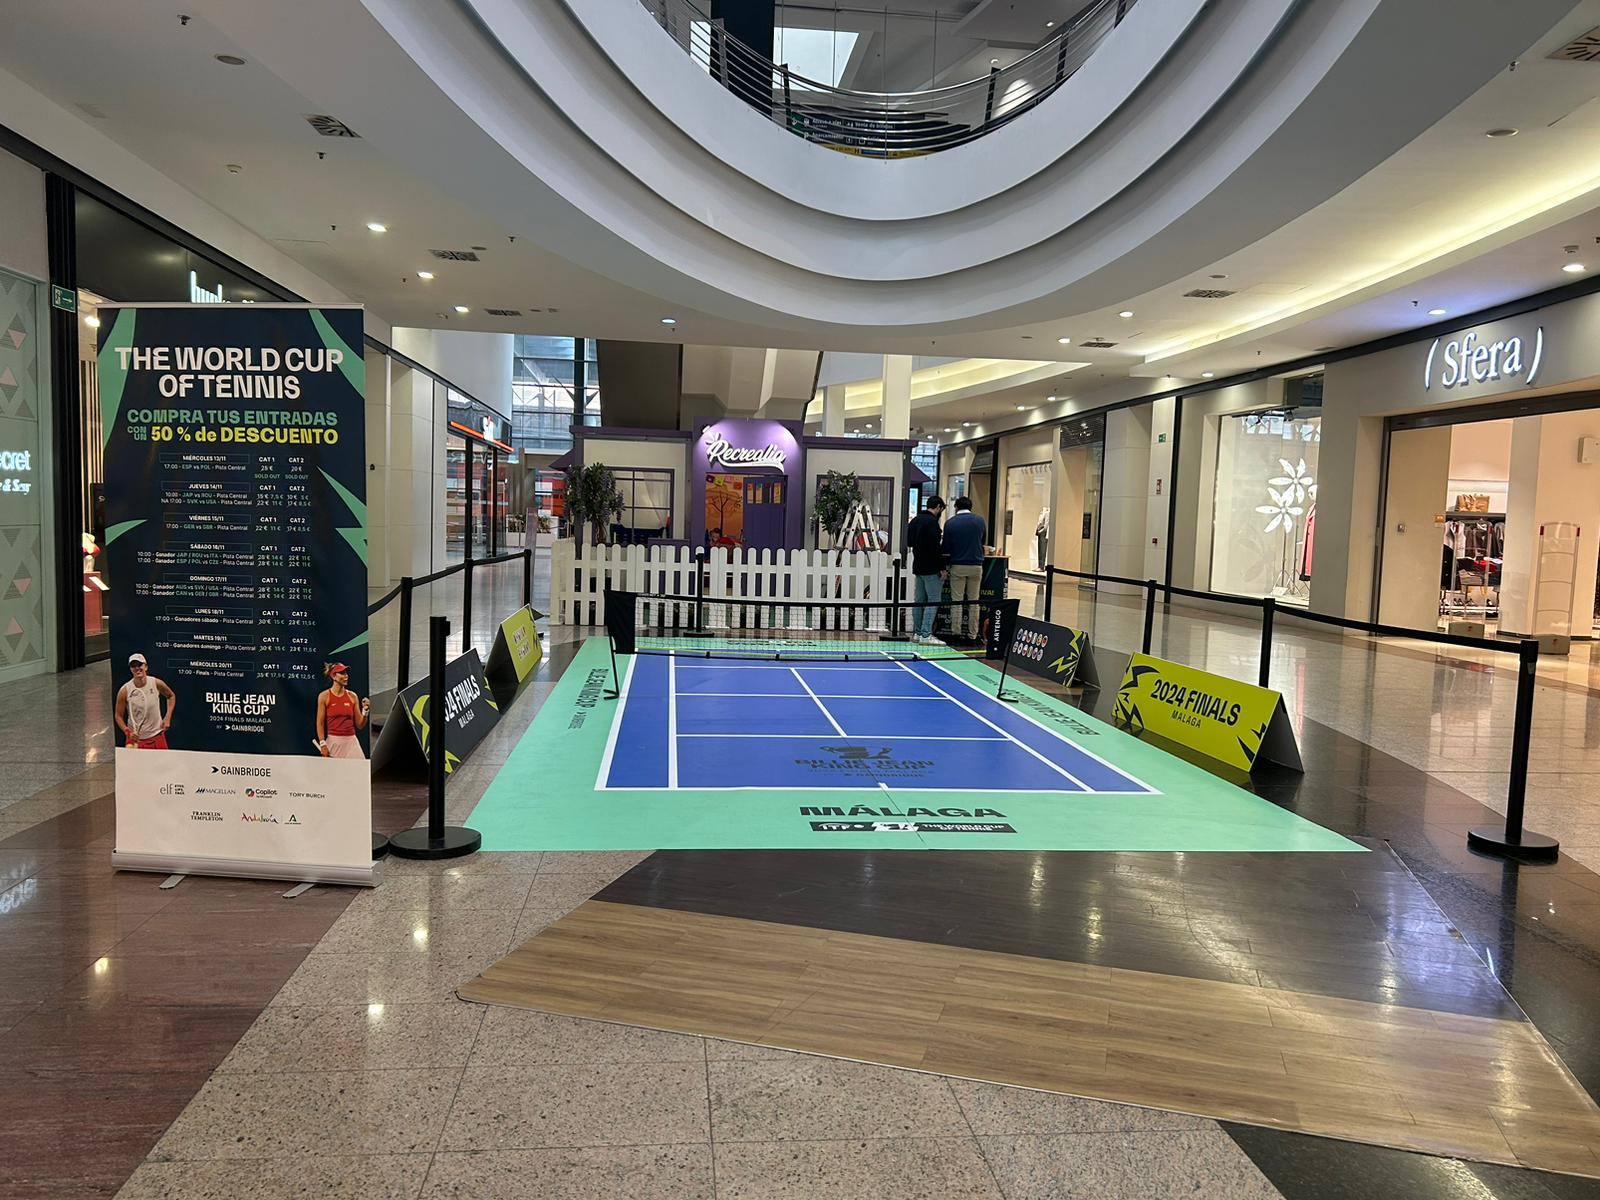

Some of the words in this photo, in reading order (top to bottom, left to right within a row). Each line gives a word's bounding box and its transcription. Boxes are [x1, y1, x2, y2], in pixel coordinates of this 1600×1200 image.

[114, 347, 170, 370] THE
[174, 347, 280, 372] WORLD
[285, 348, 344, 372] CUP
[159, 374, 194, 398] OF
[199, 375, 300, 399] TENNIS
[127, 410, 204, 424] COMPRA
[207, 410, 240, 424] TUS
[244, 411, 338, 426] ENTRADAS
[127, 426, 147, 434] CON
[152, 426, 173, 442] 50
[178, 426, 190, 442] %
[195, 427, 216, 442] de
[220, 428, 338, 444] DESCUENTO
[706, 438, 787, 472] Recrealia
[2, 478, 12, 492] &
[206, 692, 240, 704] BILLIE
[243, 694, 276, 705] JEAN
[452, 674, 480, 712] FINALS
[212, 703, 242, 714] KING
[244, 704, 270, 715] CUP
[1150, 678, 1187, 708] 2024
[1184, 690, 1242, 726] FINALS
[1171, 710, 1202, 728] MALAGA
[231, 724, 264, 732] GAINBRIDGE
[221, 766, 271, 777] GAINBRIDGE
[800, 804, 1008, 818] MÁLAGA
